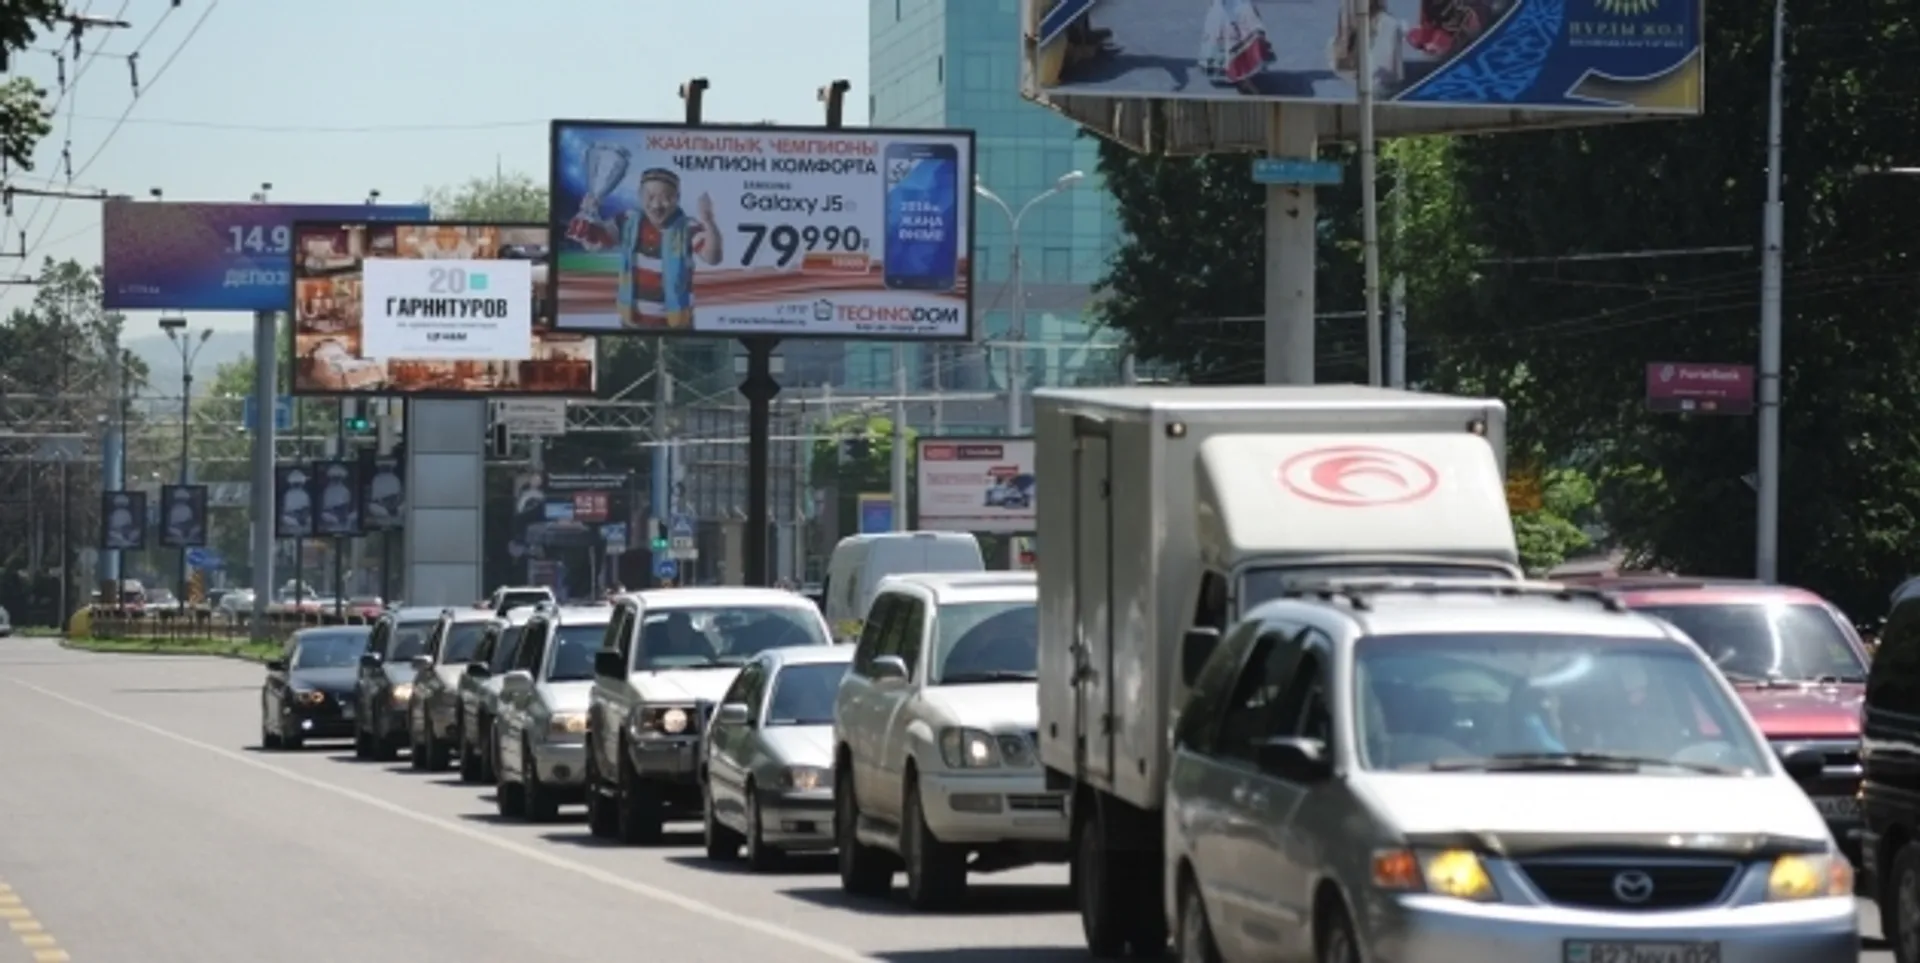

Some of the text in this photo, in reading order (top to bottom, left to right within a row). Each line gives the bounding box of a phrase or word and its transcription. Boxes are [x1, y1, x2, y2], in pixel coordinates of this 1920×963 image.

[769, 138, 879, 156] ЧЕМПИОНЫ
[672, 154, 767, 172] ЧЕМПИОН
[771, 156, 878, 175] КОМФОРТА
[740, 192, 843, 216] Galaxy J5
[428, 267, 467, 294] 20
[385, 297, 508, 318] ГАРНИТУРОВ
[838, 305, 959, 324] TECHNODOM
